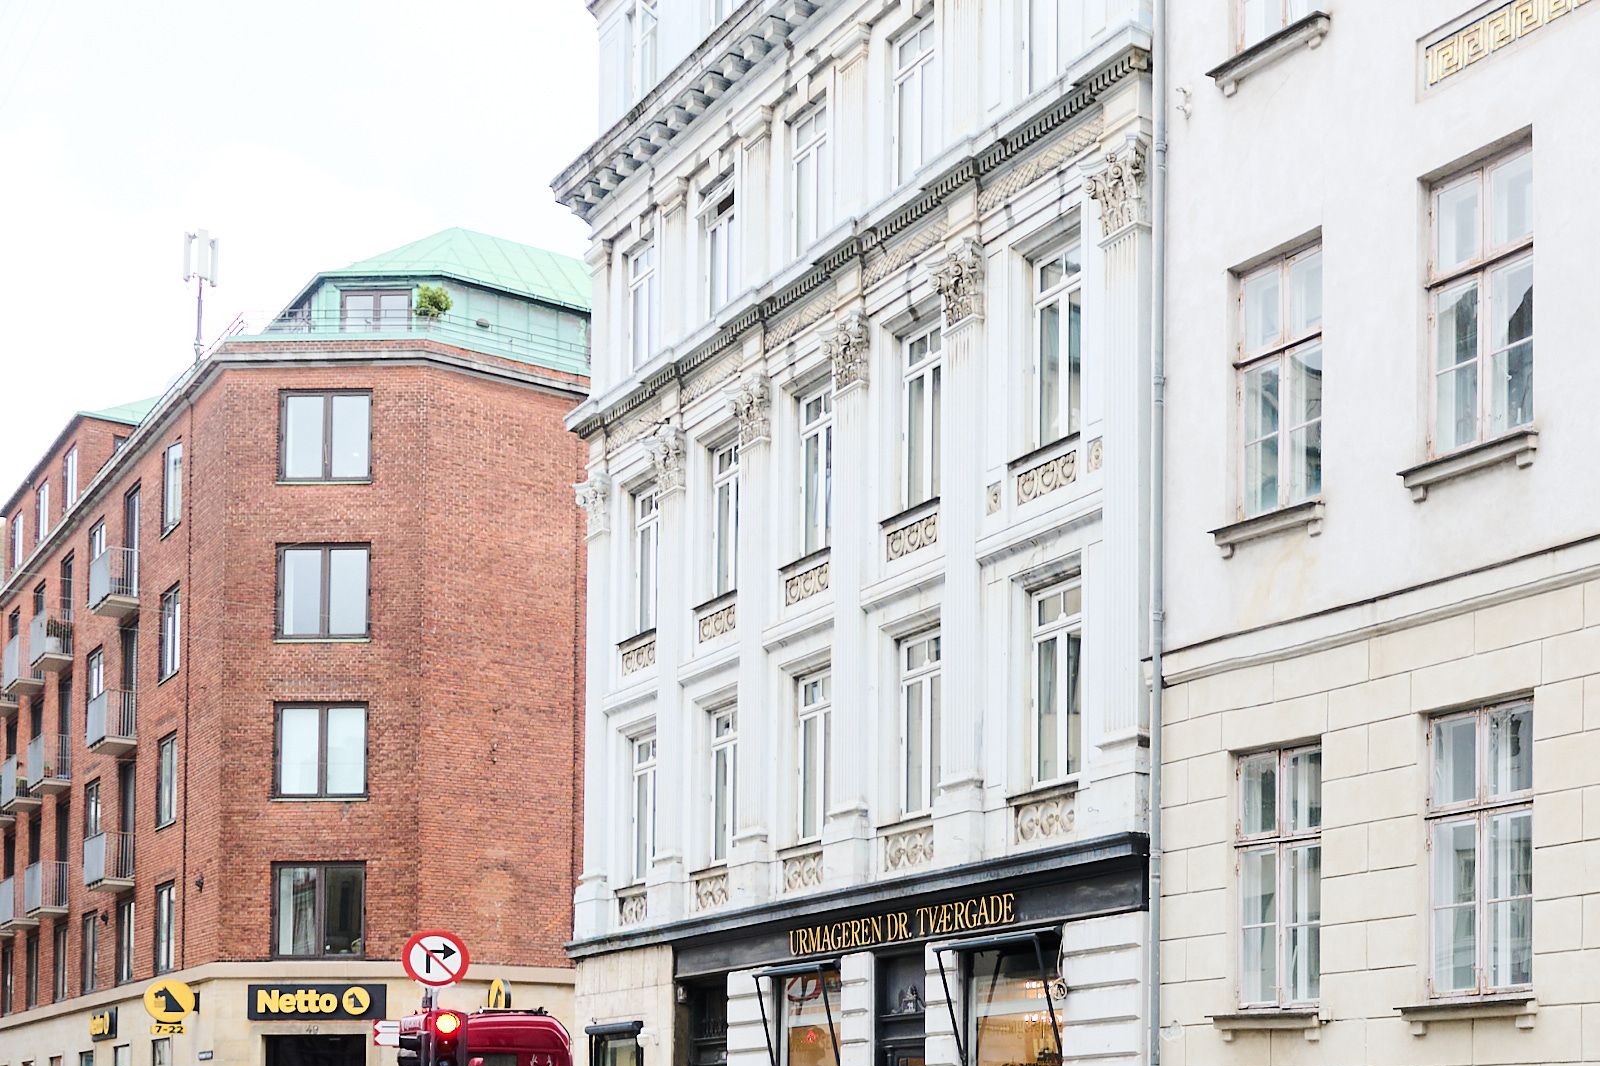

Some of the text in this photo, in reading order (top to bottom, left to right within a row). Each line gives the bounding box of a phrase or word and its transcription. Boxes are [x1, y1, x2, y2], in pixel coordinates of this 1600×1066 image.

[789, 893, 1015, 956] URMAGEREN DR. TVÆRGADE
[257, 989, 338, 1013] Netto
[155, 1025, 184, 1034] 7-22
